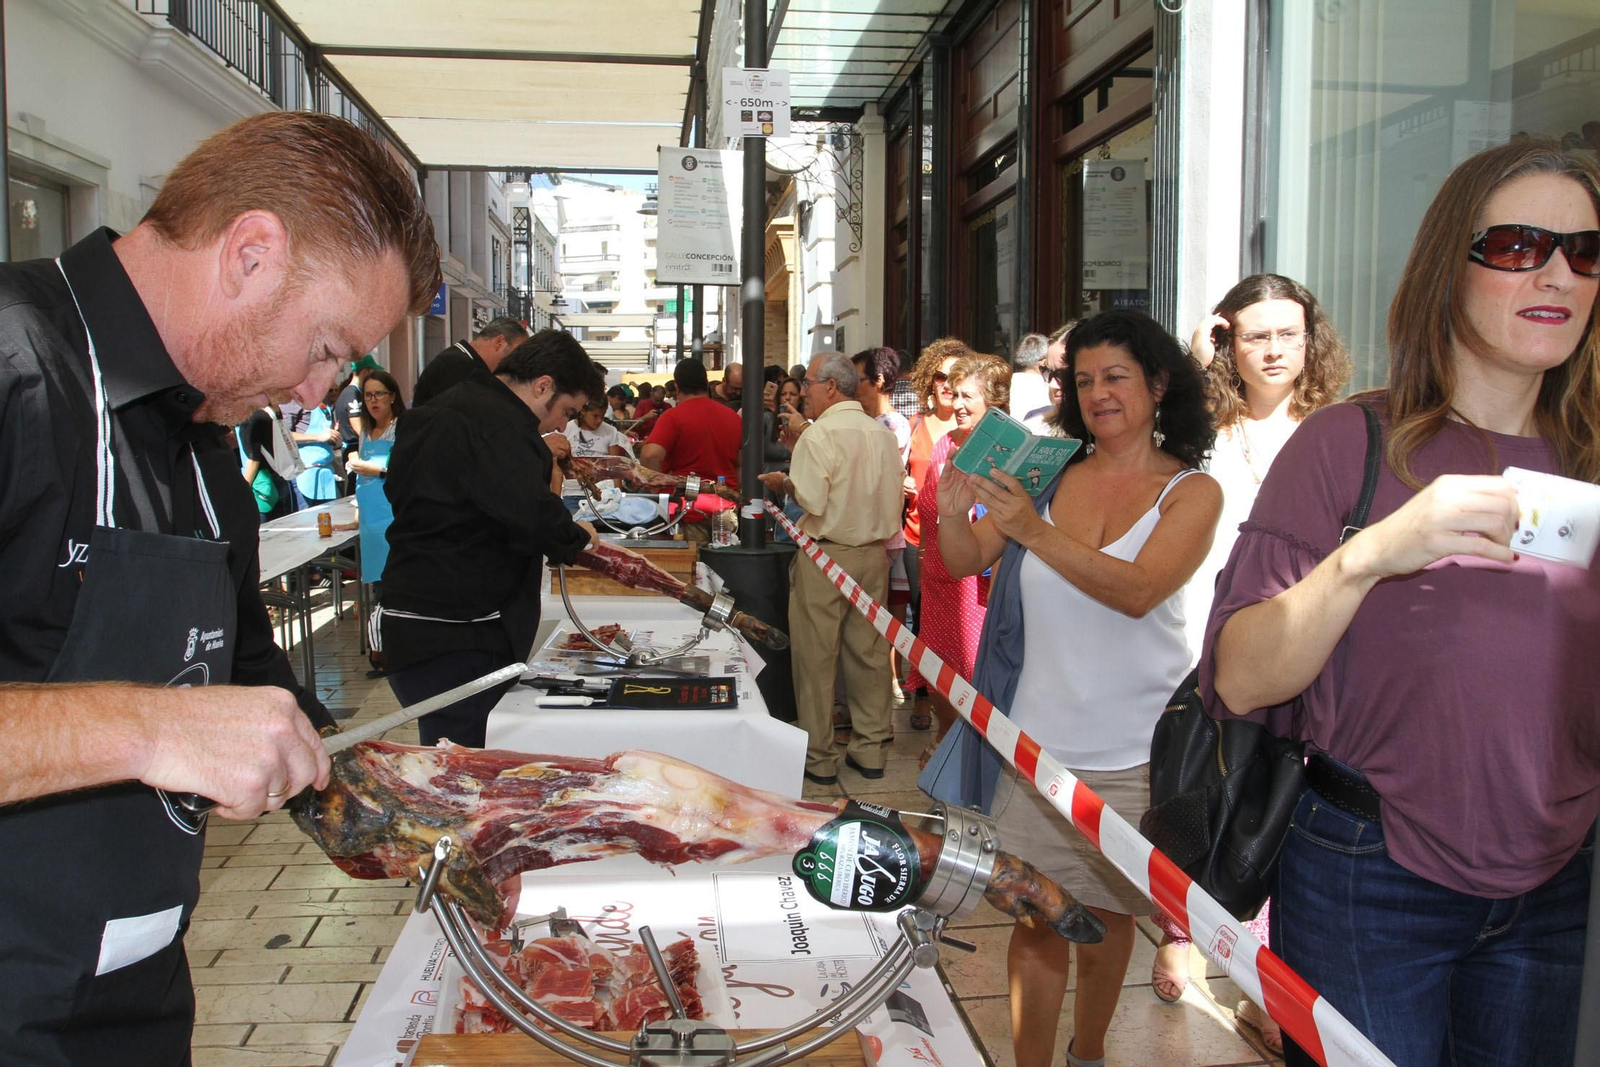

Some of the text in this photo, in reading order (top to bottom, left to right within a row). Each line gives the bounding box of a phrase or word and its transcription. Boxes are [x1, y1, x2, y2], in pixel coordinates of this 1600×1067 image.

[740, 97, 774, 108] 650m
[802, 858, 815, 870] 3
[884, 842, 908, 904] FLOR SIERRA DE
[777, 876, 811, 955] Joaquin Chavez
